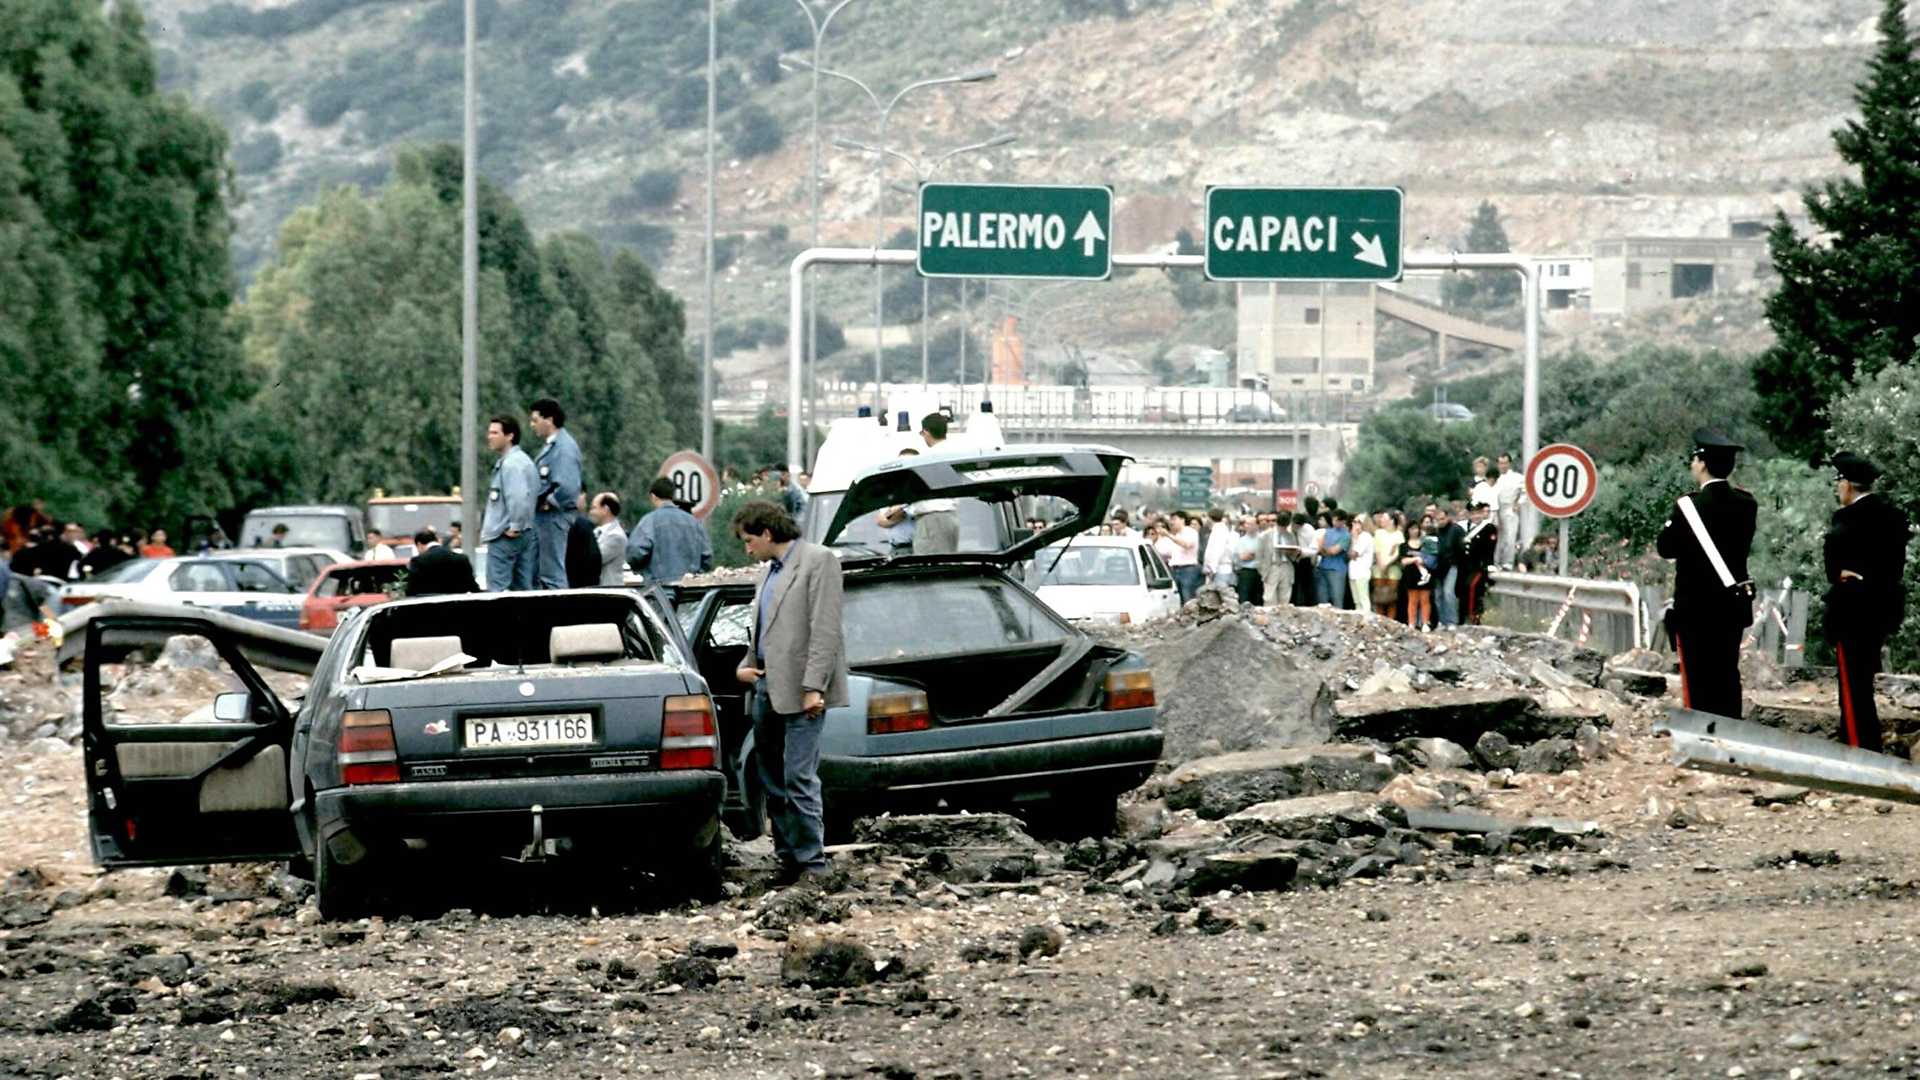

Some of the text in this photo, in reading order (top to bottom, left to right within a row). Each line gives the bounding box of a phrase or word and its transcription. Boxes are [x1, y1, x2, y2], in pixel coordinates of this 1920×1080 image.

[923, 211, 1066, 250] PALERMO
[1213, 215, 1338, 252] CAPACI
[673, 469, 702, 503] 80
[1542, 463, 1579, 499] 80
[474, 718, 588, 743] PA 931166
